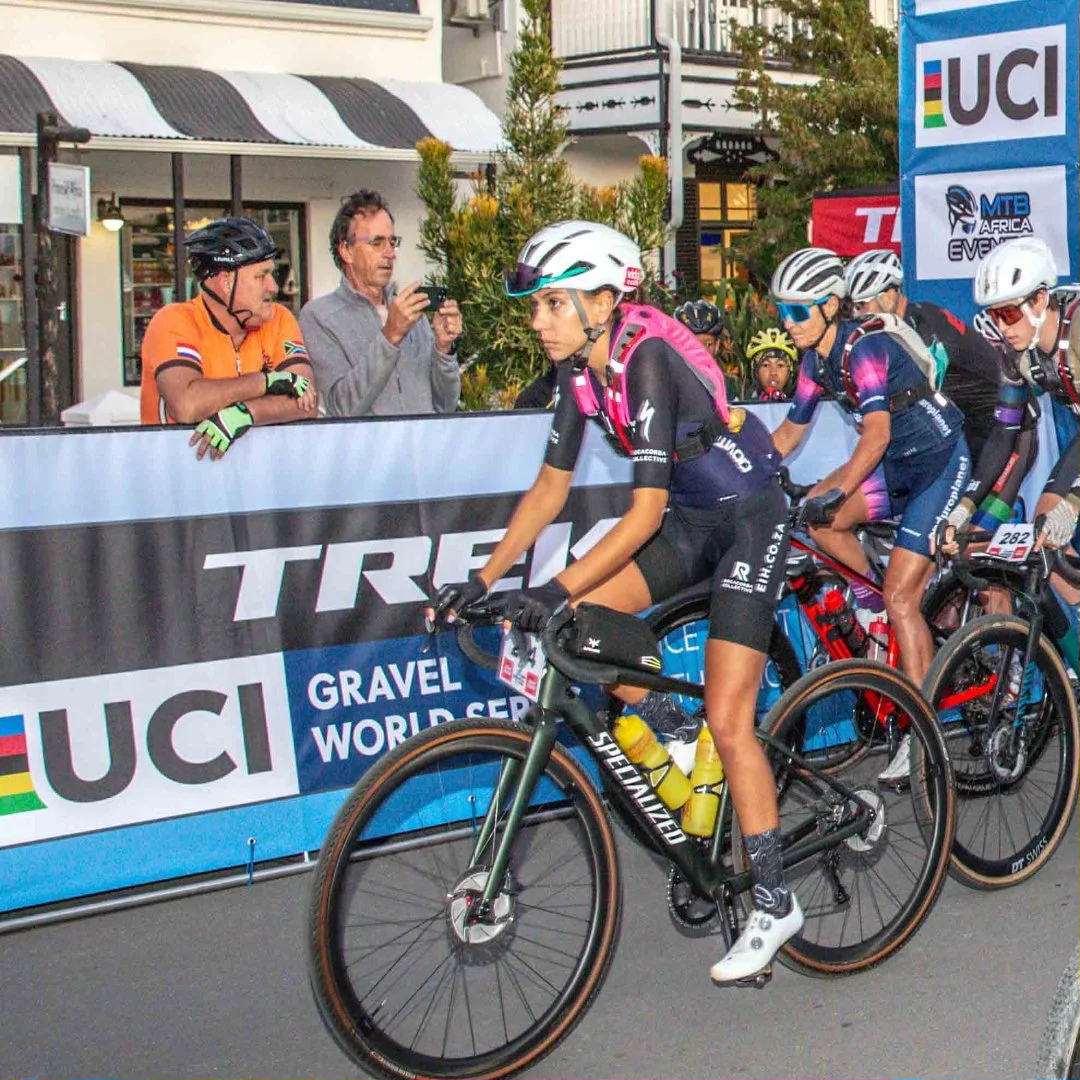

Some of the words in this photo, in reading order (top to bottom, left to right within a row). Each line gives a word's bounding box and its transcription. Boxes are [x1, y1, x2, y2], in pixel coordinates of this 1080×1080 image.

[948, 45, 1058, 126] UCI
[979, 217, 1034, 235] AFRICA
[980, 192, 1031, 218] MTB
[713, 435, 753, 474] CIOVIT
[754, 523, 785, 593] EIH.CO.ZA
[998, 532, 1031, 545] 282
[308, 656, 462, 710] GRAVEL
[38, 682, 273, 803] UCI
[588, 731, 688, 845] SPECIALIZED
